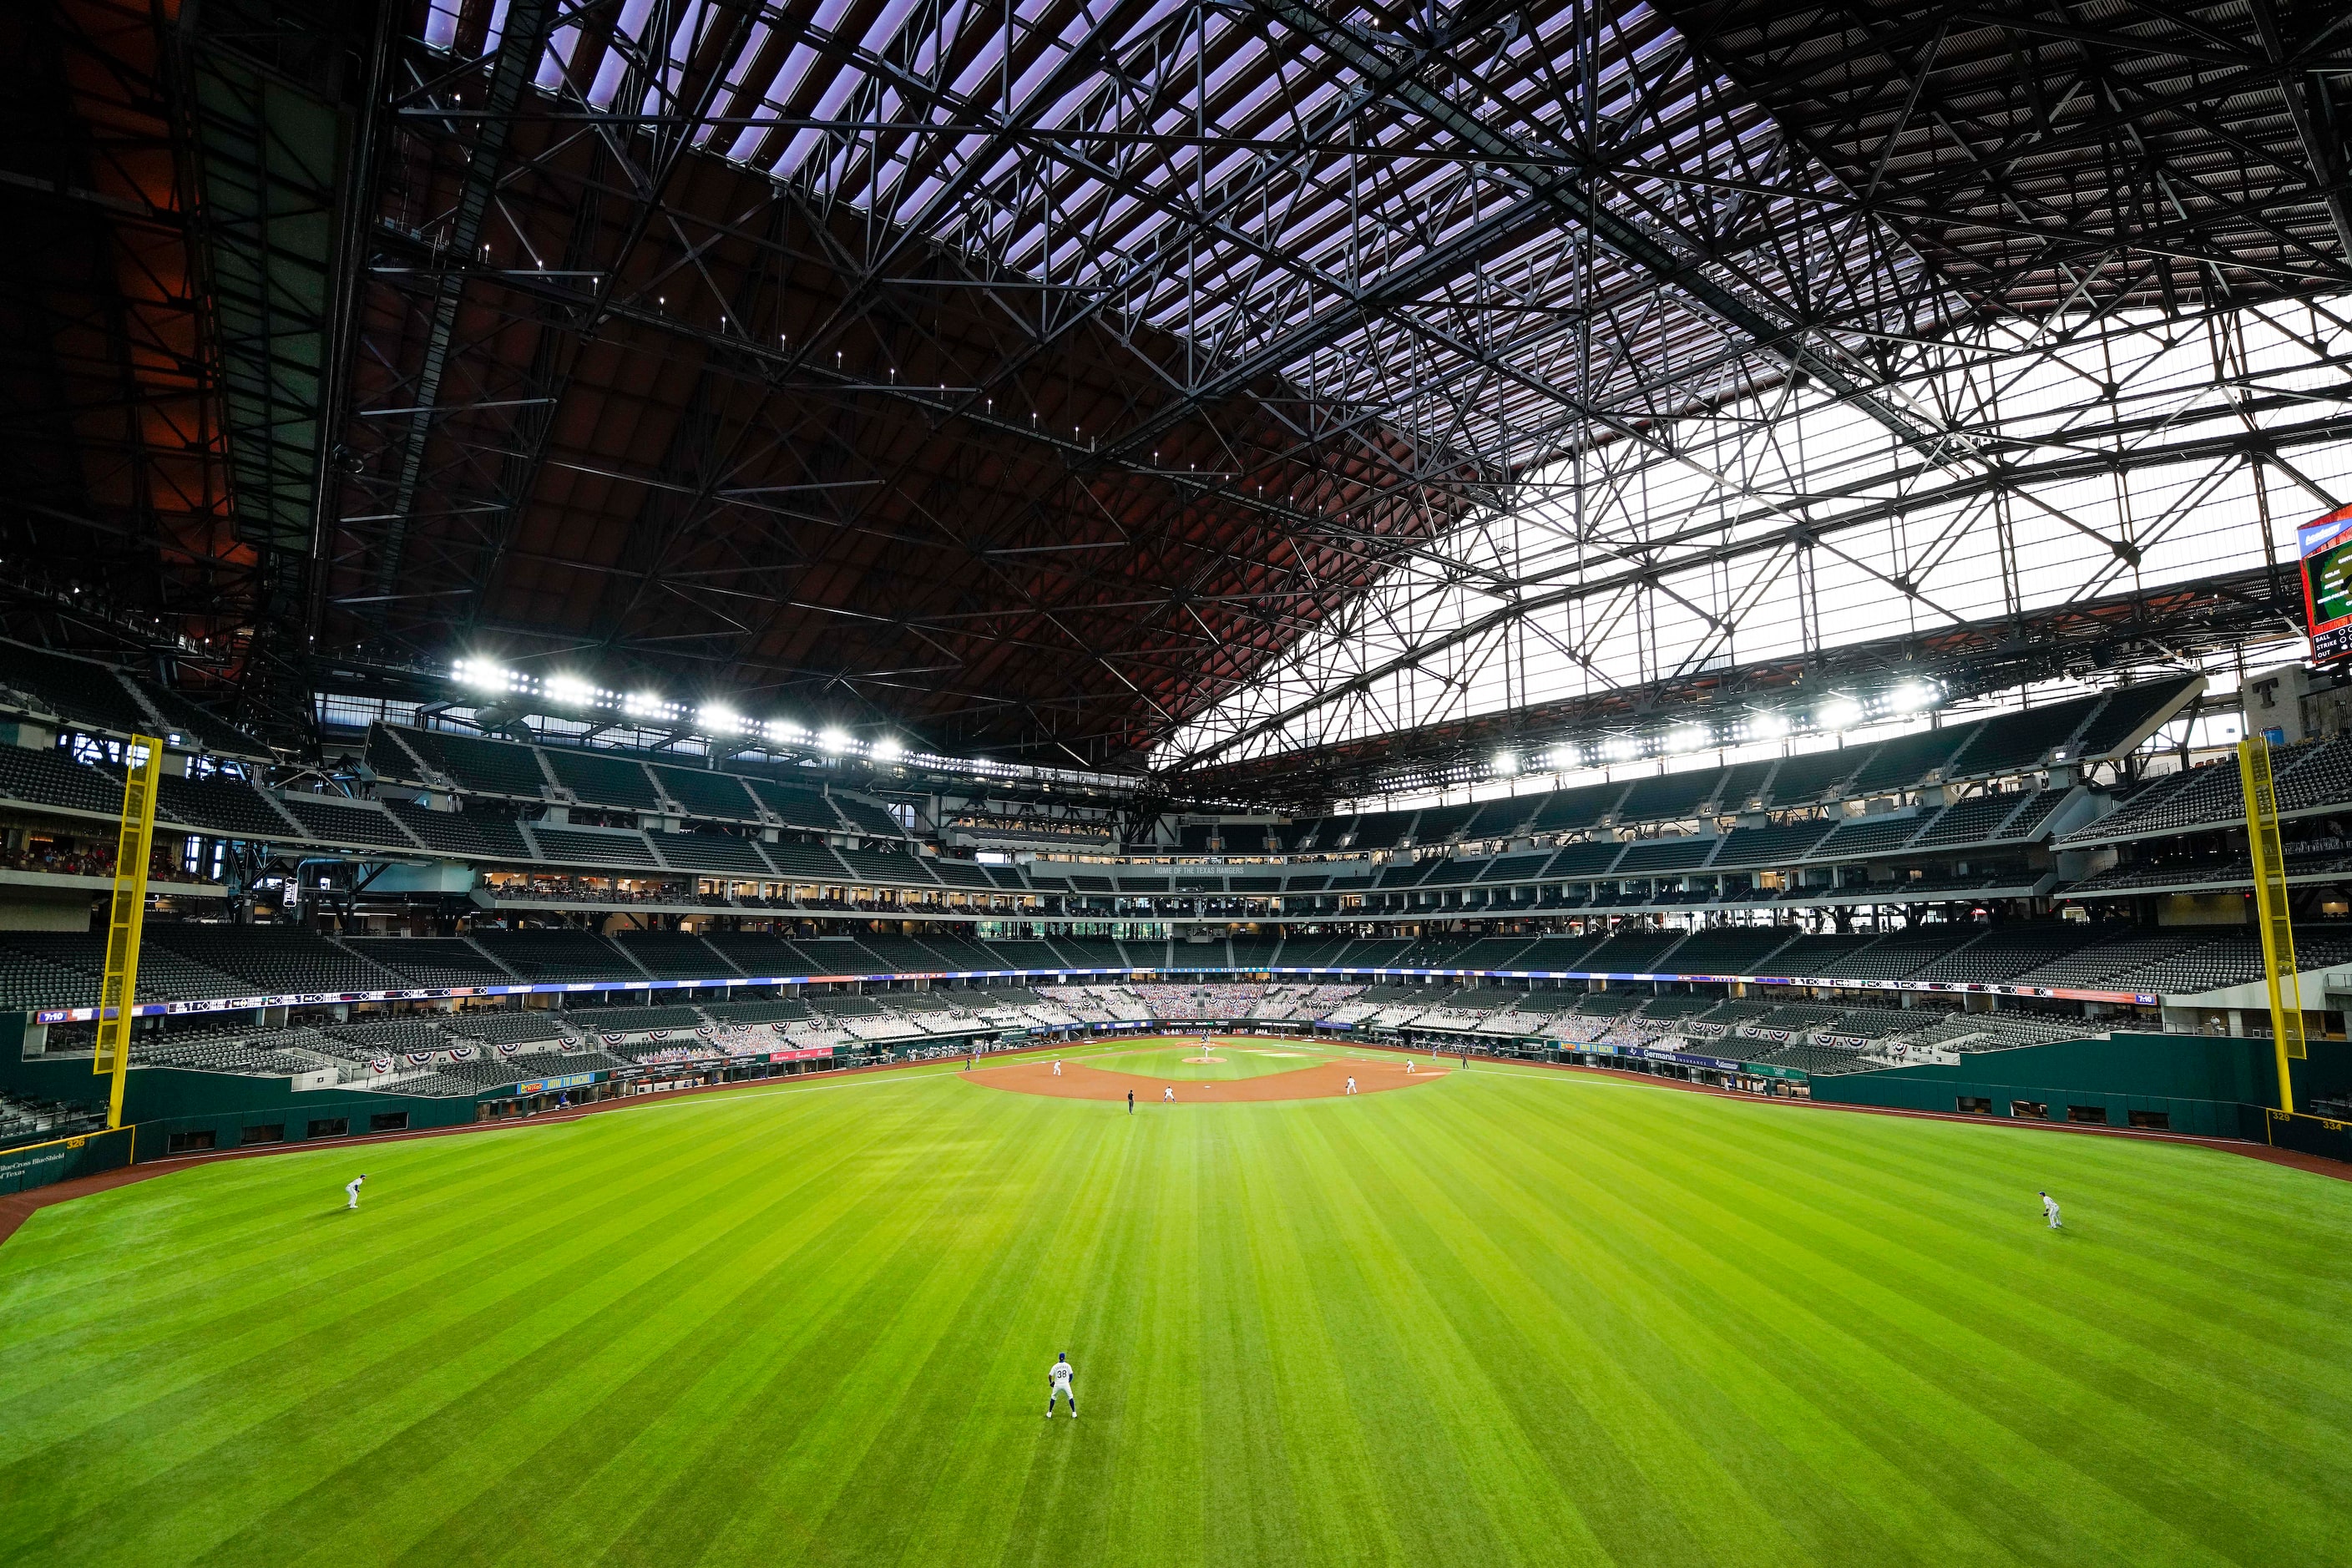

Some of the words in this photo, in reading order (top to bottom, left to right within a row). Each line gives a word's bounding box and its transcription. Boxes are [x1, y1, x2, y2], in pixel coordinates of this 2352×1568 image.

[2315, 635, 2330, 643] BALL
[2316, 640, 2337, 650] STRIKE
[2252, 677, 2279, 709] T
[44, 1012, 63, 1021] 7:10
[1643, 1049, 1677, 1061] Germania
[1677, 1058, 1707, 1066] INSURANCE
[547, 1078, 562, 1089] HOW
[563, 1077, 569, 1085] TO
[2272, 1112, 2291, 1122] 329
[2323, 1120, 2342, 1131] 334
[67, 1138, 85, 1150] 326
[32, 1152, 65, 1166] BlueShield
[6, 1170, 26, 1179] Texas
[1057, 1370, 1067, 1378] 38
